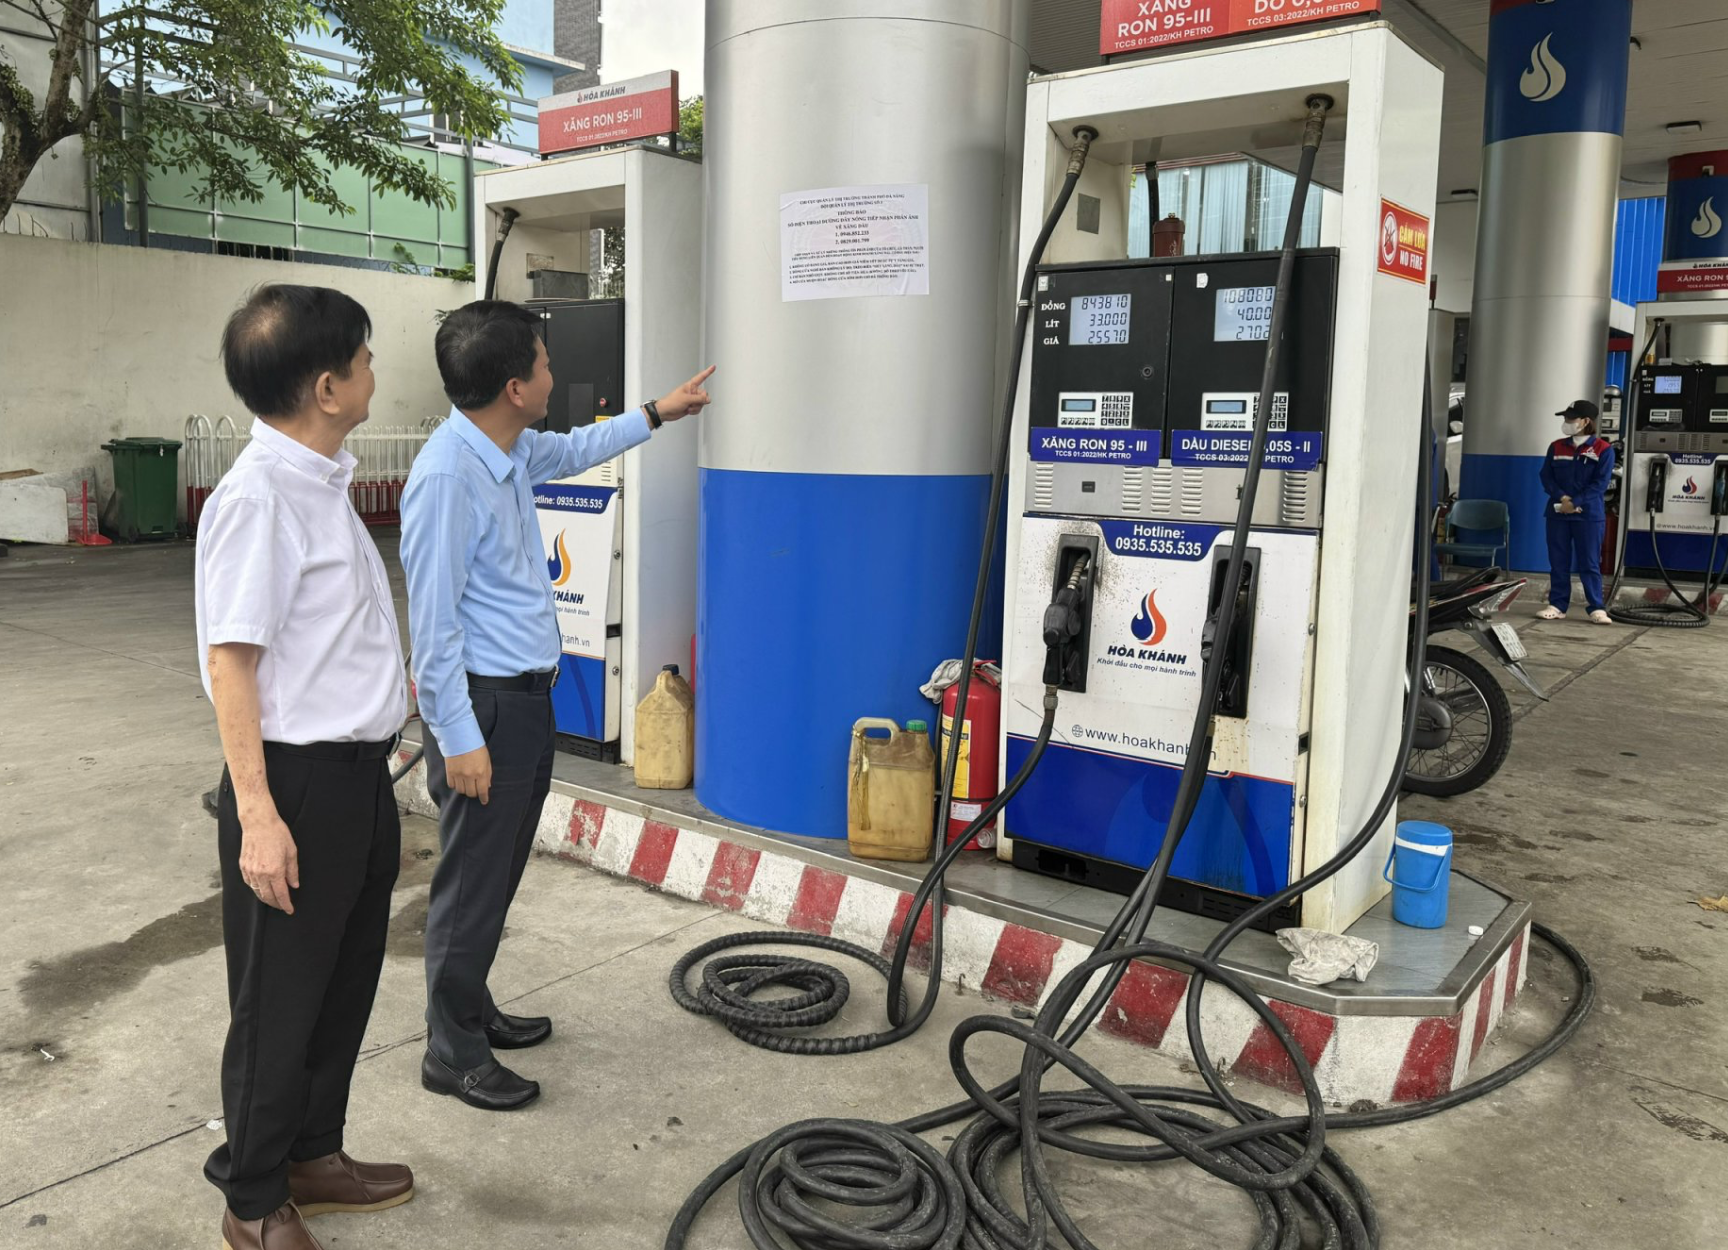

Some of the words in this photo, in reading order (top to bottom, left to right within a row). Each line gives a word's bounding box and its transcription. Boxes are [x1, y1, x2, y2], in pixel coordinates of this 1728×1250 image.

[1247, 16, 1271, 26] TCCS
[1326, 1, 1359, 13] PETRO
[1118, 18, 1157, 37] RON
[1164, 8, 1210, 29] 95-III
[1115, 40, 1136, 49] TCCS
[1184, 26, 1214, 37] PETRO
[563, 117, 590, 132] XĂNG
[593, 113, 614, 127] RON
[617, 107, 642, 123] 95-III
[1400, 250, 1409, 266] NO
[1410, 254, 1423, 271] FIRE
[1041, 300, 1066, 311] ĐỒNG
[1082, 295, 1128, 310] 843810
[1045, 319, 1060, 328] LÍT
[1090, 312, 1127, 326] 33.000
[1088, 330, 1126, 344] 25570
[1042, 436, 1076, 449] XĂNG
[1080, 439, 1106, 450] RON
[1111, 440, 1125, 451] 95
[1182, 436, 1207, 450] DẦU
[1264, 440, 1292, 453] ,05S
[534, 495, 555, 504] otline:
[557, 496, 603, 509] 0935.535.535
[1133, 524, 1185, 539] Hotline:
[1115, 537, 1202, 556] 0935.535.535
[1107, 645, 1135, 658] HÒA
[1138, 650, 1187, 665] KHÁNH
[1115, 660, 1128, 668] đầu
[1160, 666, 1177, 674] hành
